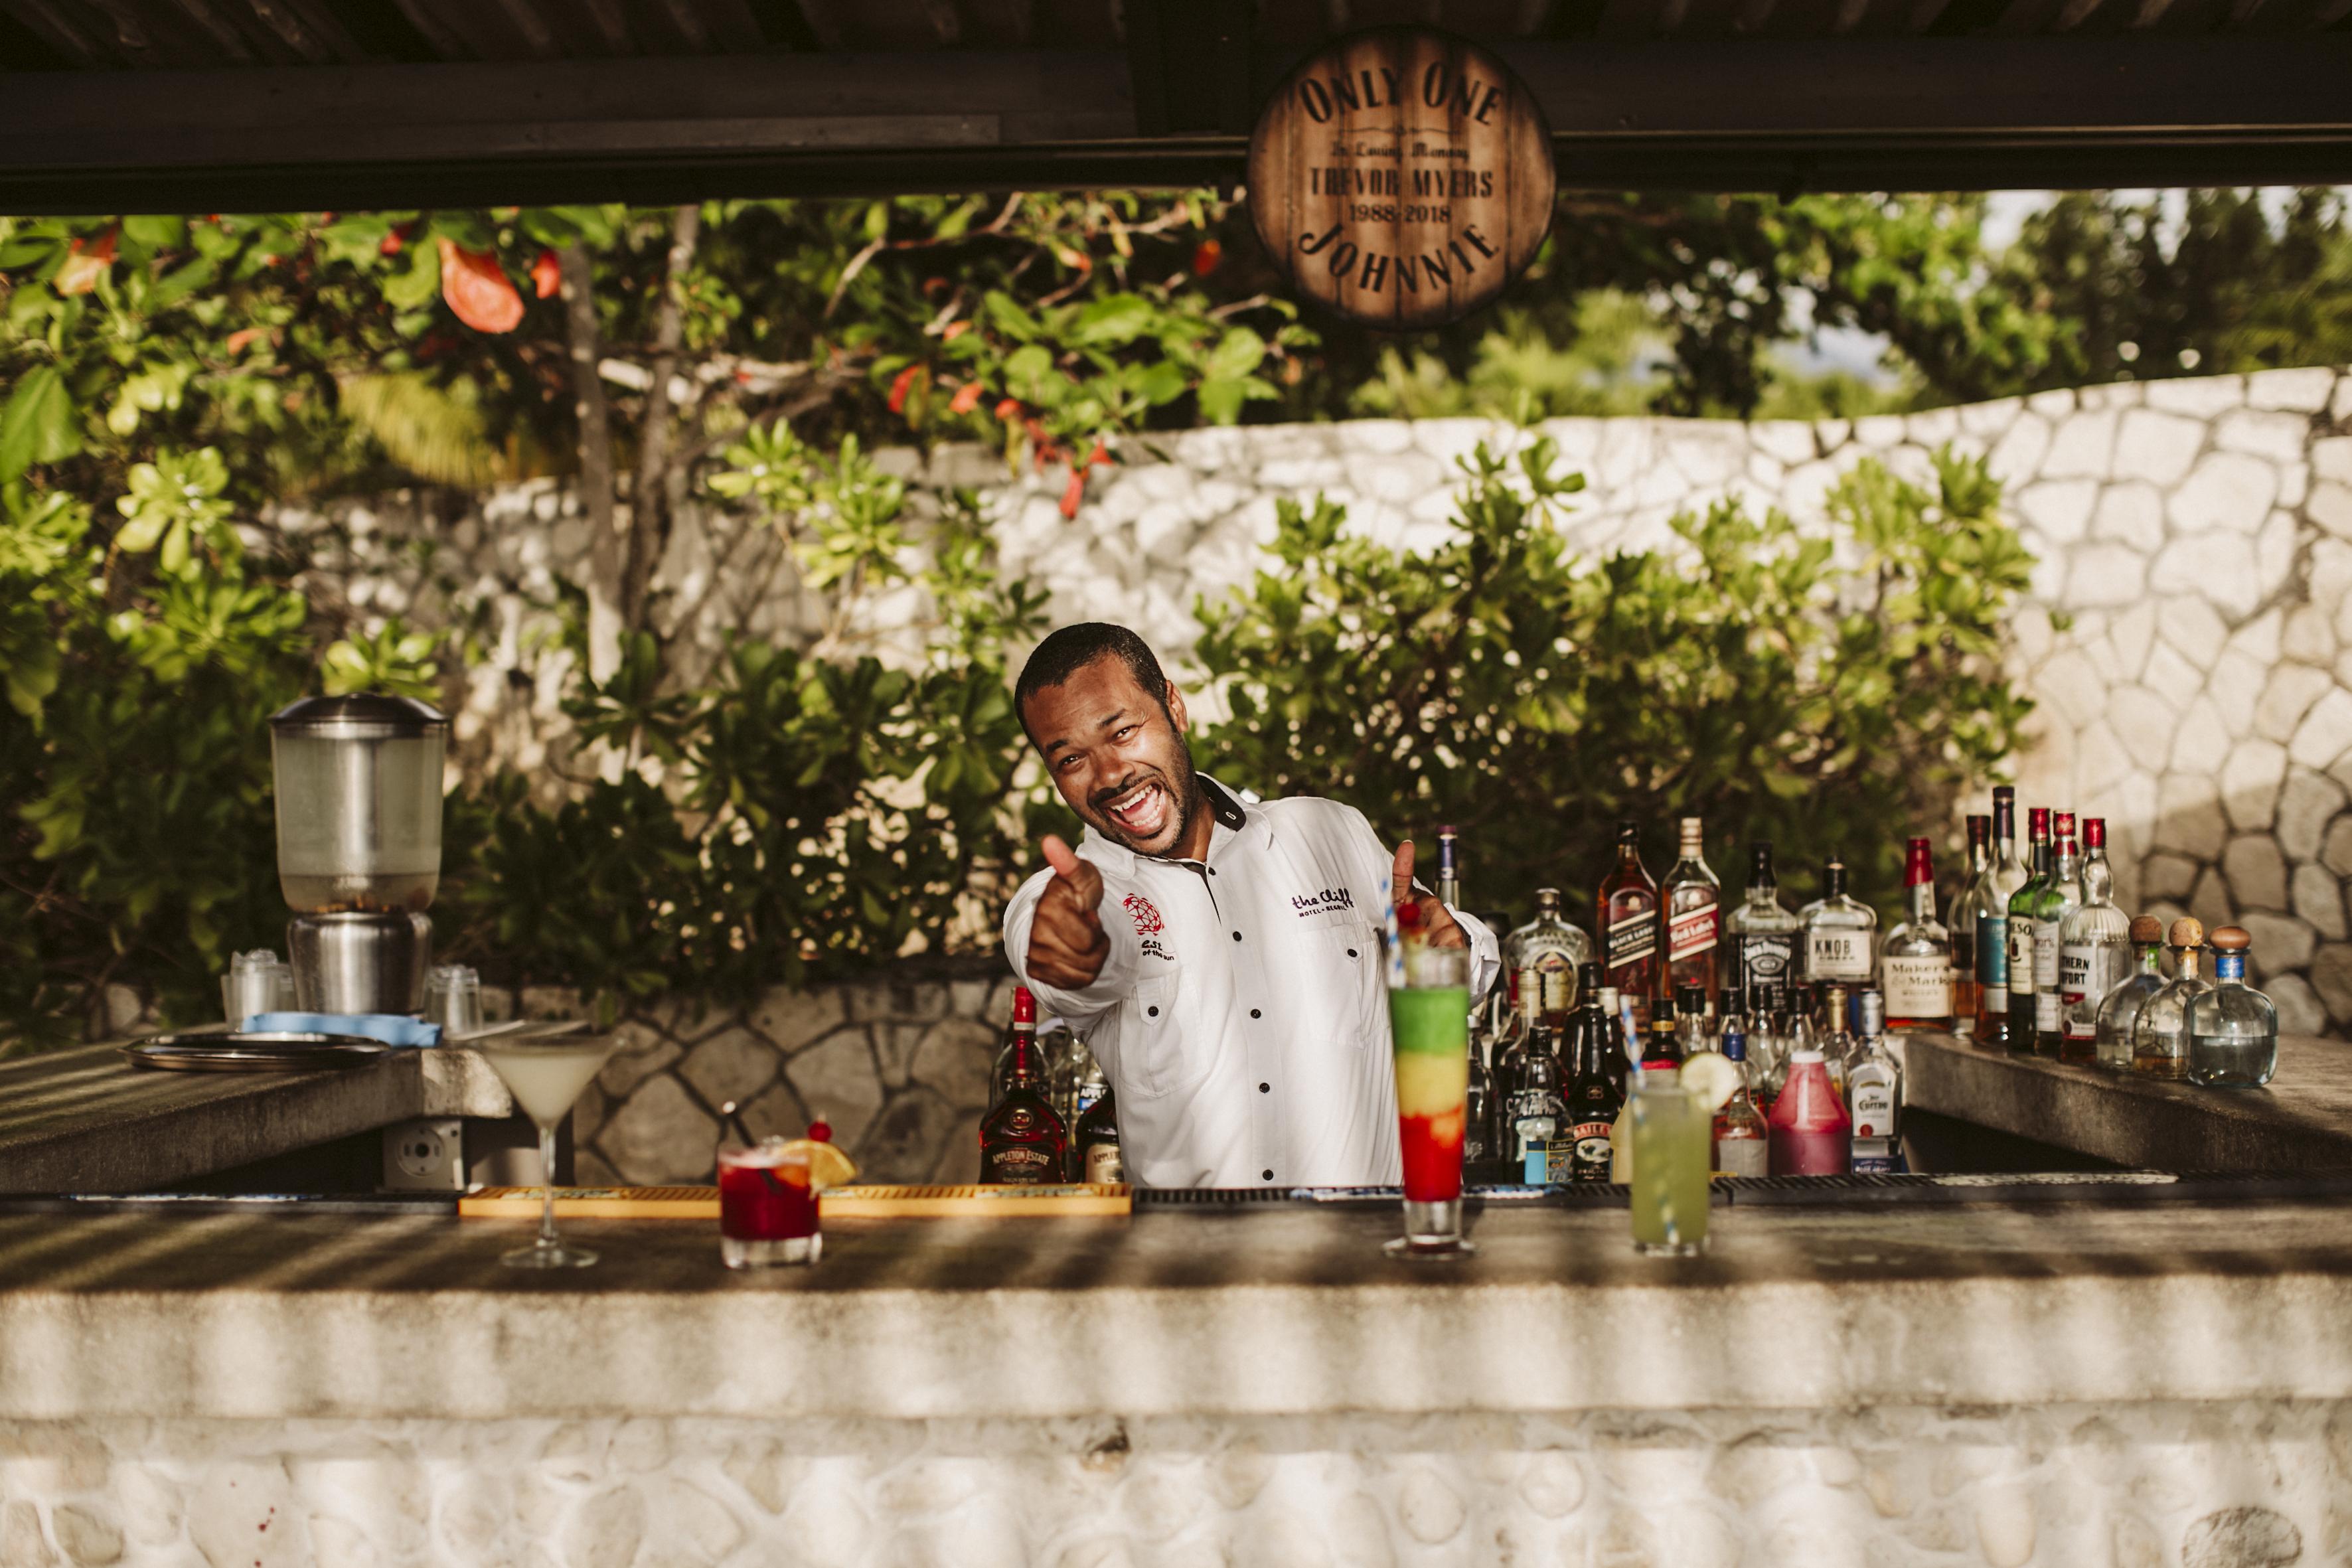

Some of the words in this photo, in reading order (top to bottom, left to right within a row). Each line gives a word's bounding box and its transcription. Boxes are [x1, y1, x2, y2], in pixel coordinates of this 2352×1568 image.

[1299, 67, 1401, 124] ONLY
[1423, 61, 1504, 125] ONE
[1310, 167, 1399, 195] TREVOR
[1413, 169, 1493, 198] MYERS
[1298, 222, 1500, 294] JOHNNIE
[1292, 895, 1319, 909] the
[1320, 888, 1354, 907] Cliff
[1815, 939, 1850, 955] KNOB
[2061, 955, 2090, 971] THERN
[992, 1149, 1025, 1164] APPLETON
[1026, 1149, 1050, 1166] ESTATE
